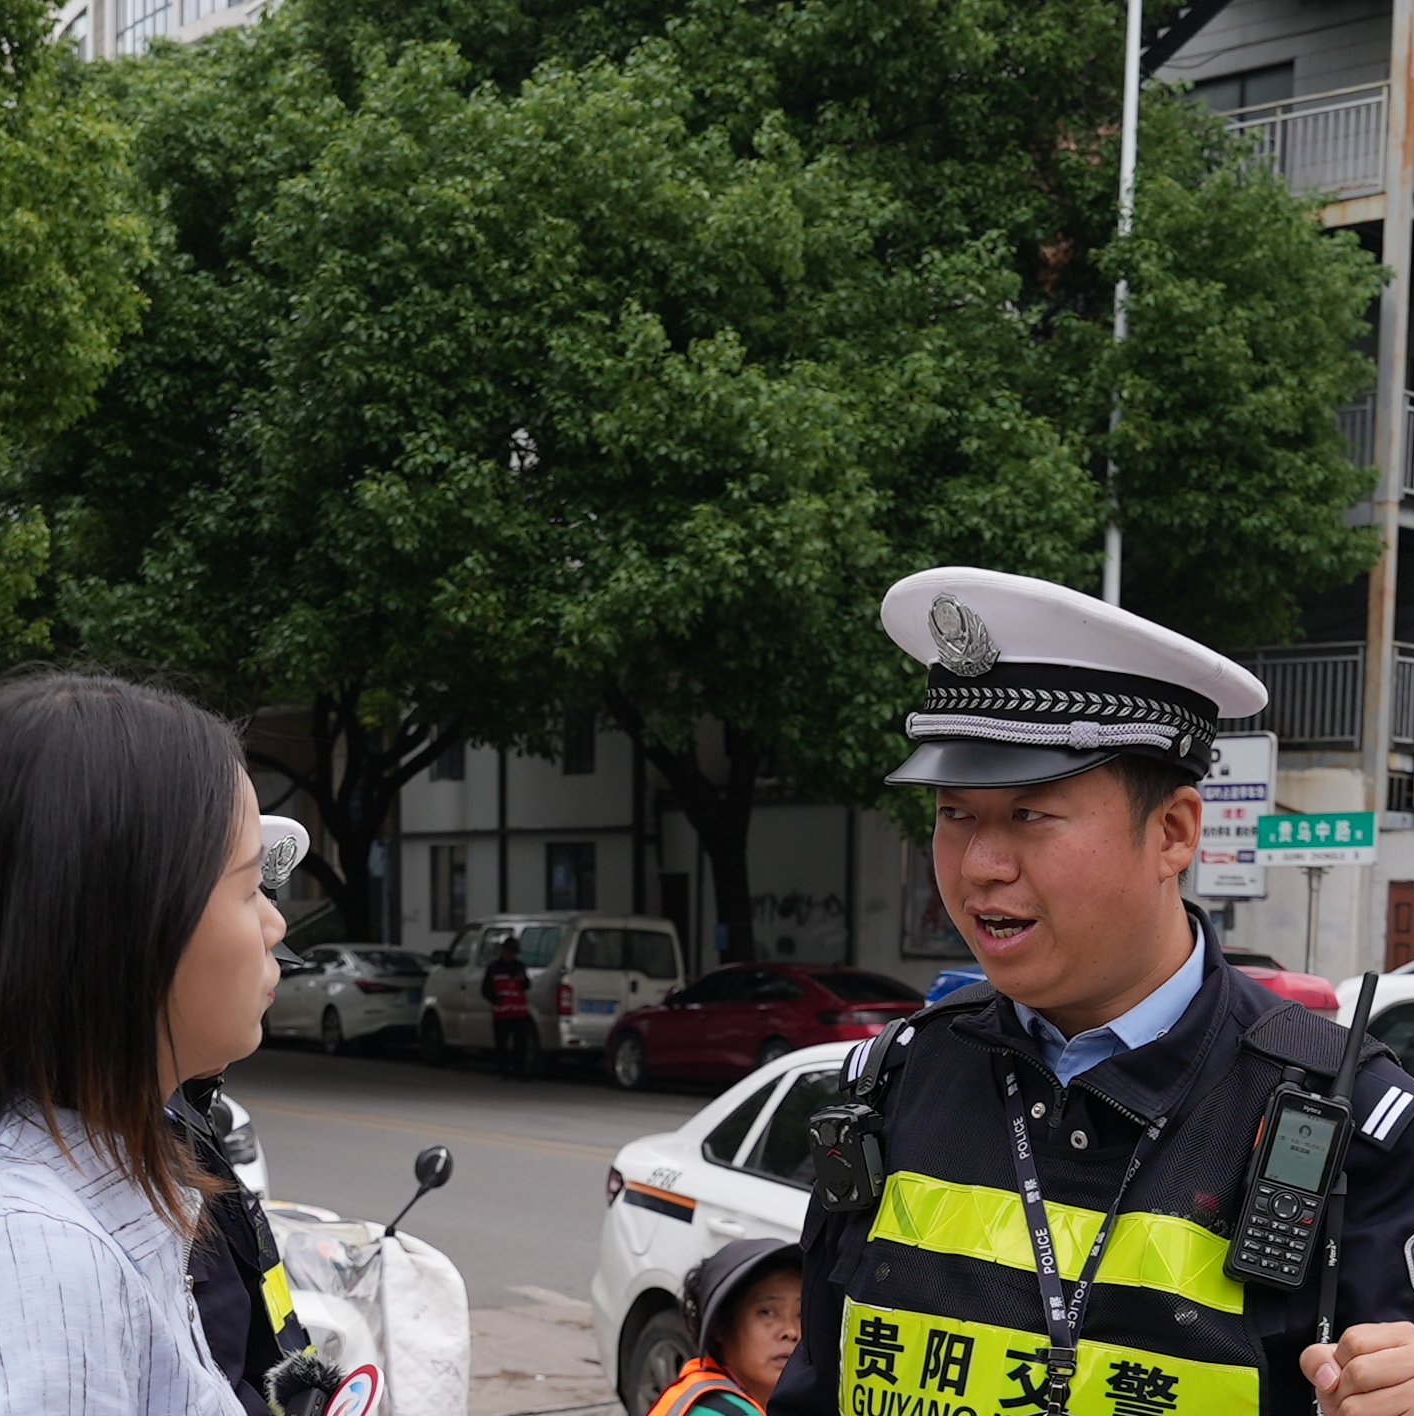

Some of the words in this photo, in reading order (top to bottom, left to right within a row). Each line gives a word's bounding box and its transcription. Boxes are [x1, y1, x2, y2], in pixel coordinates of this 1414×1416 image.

[1012, 1115, 1031, 1160] POLICE
[1034, 1227, 1056, 1275] POLICE
[1067, 1280, 1088, 1329] POLICE
